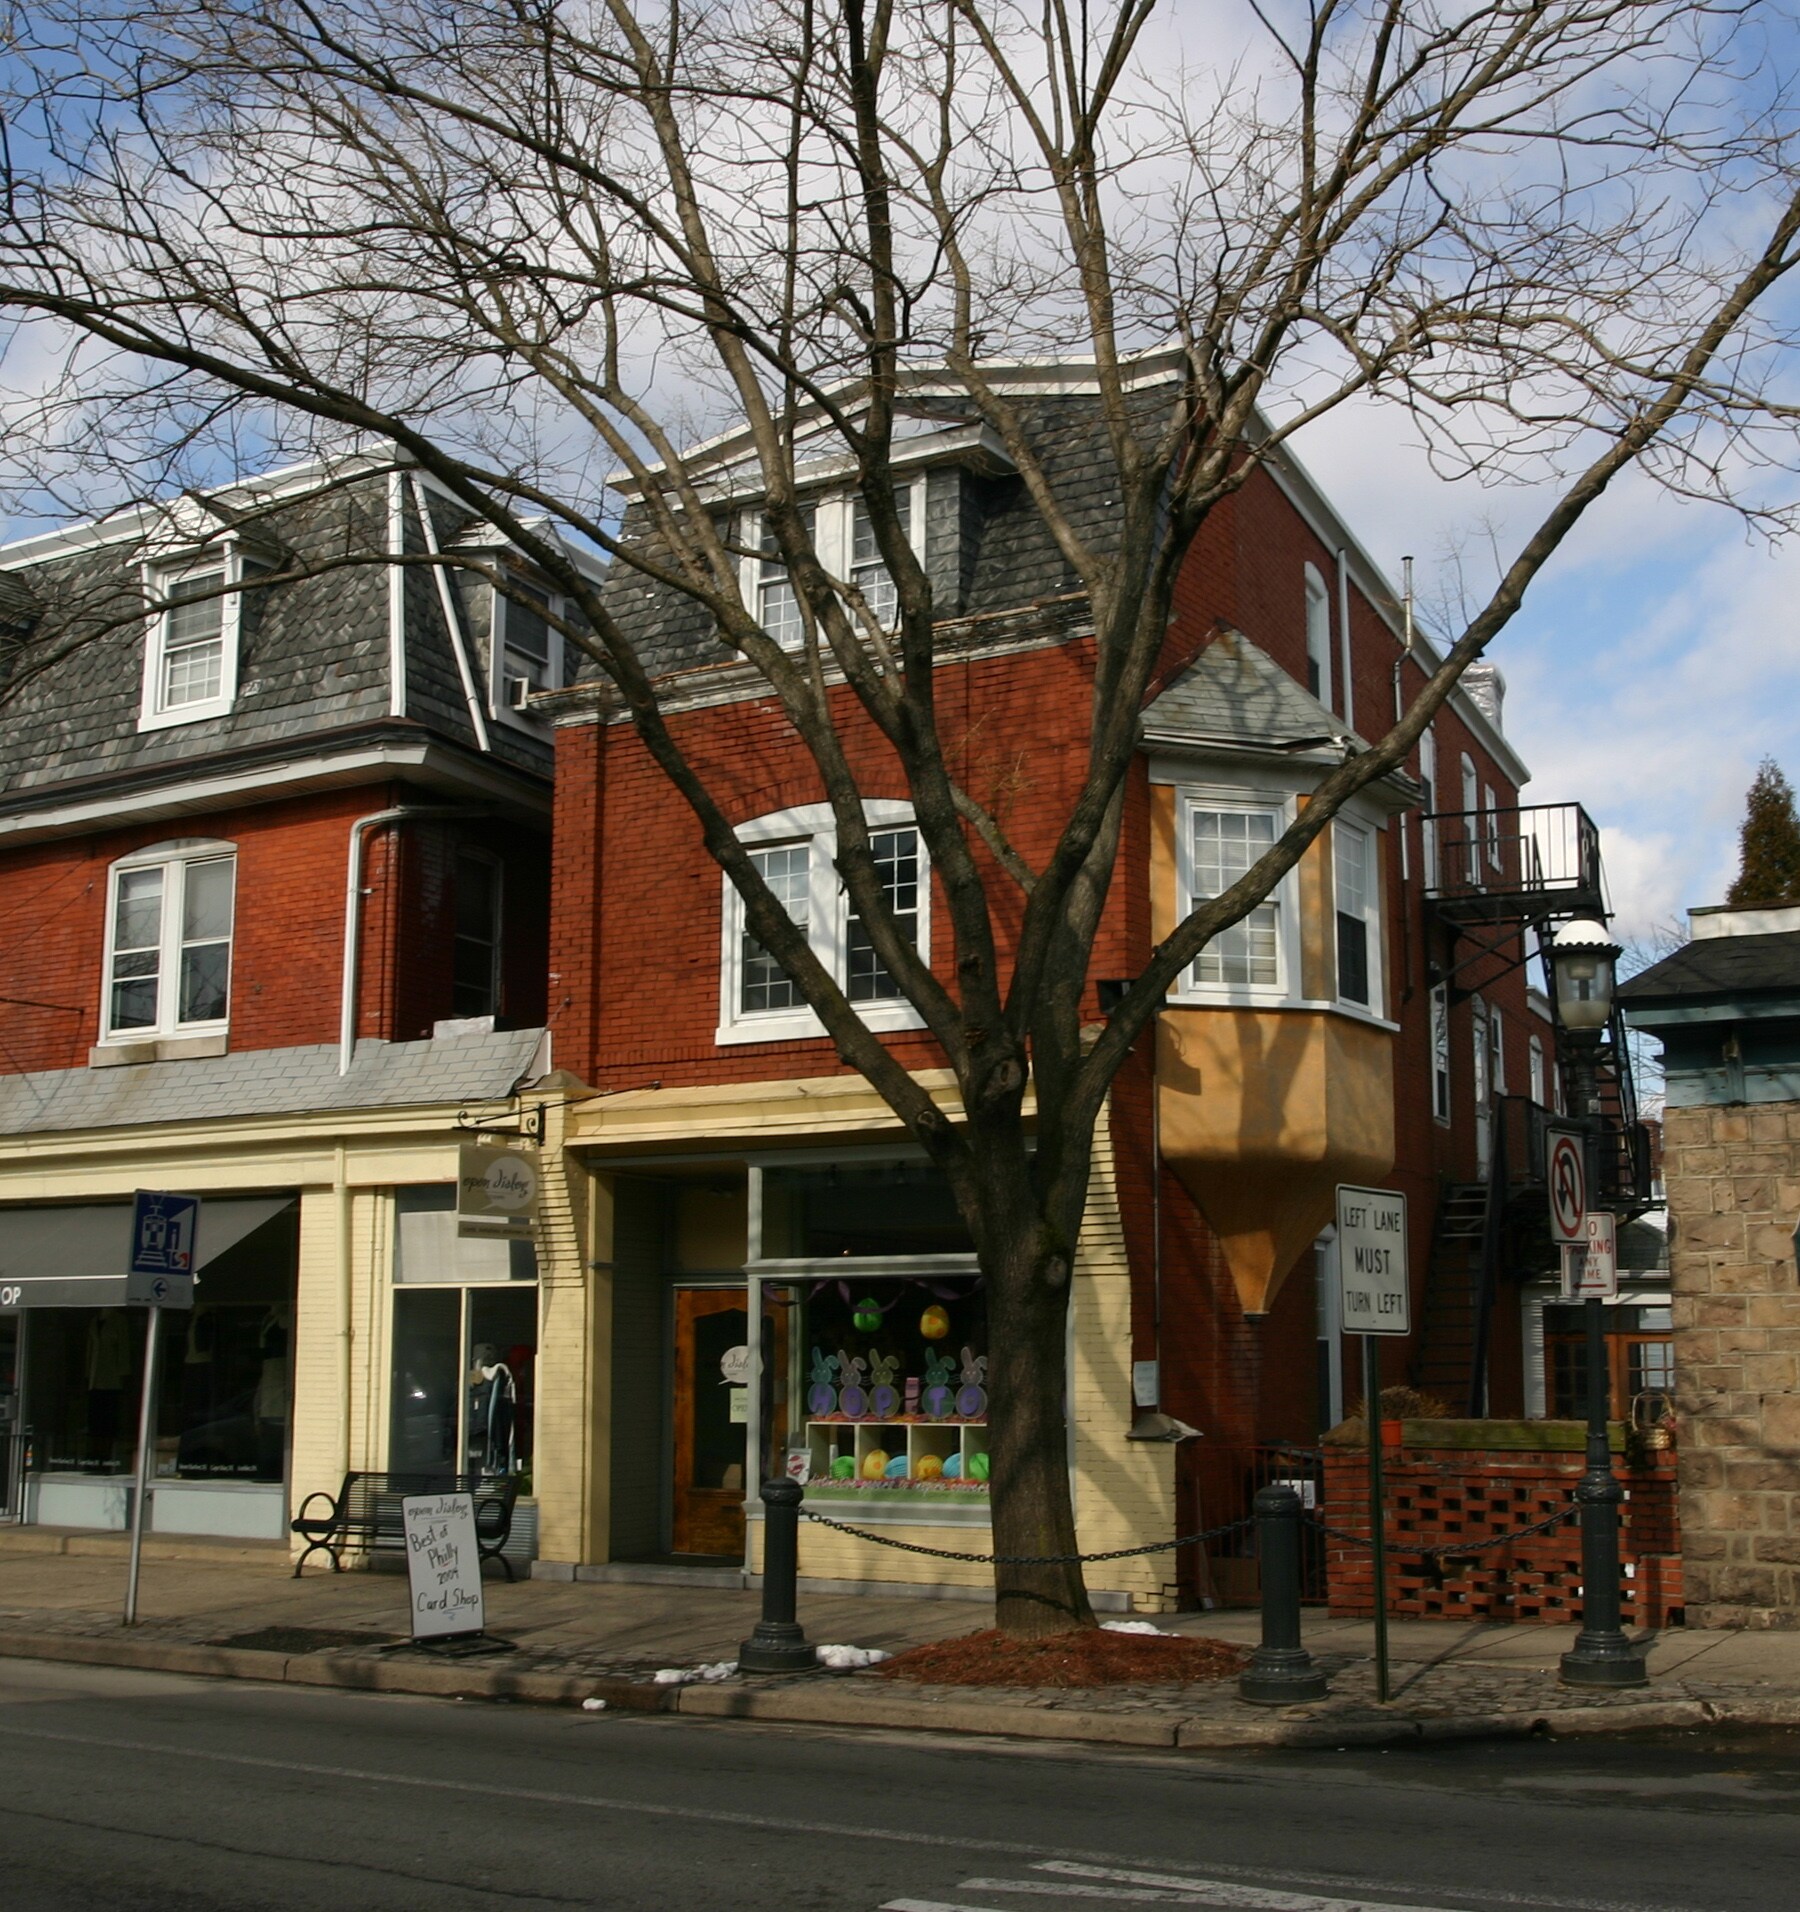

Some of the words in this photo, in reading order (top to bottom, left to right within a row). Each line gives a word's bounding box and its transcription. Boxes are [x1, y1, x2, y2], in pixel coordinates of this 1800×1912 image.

[463, 1177, 490, 1192] open
[493, 1168, 529, 1199] dialog
[1343, 1206, 1367, 1228] LEFT
[1374, 1210, 1400, 1233] LANE
[1589, 1221, 1597, 1236] O
[1355, 1247, 1391, 1275] MUST
[1576, 1269, 1601, 1280] TIME
[0, 1286, 22, 1305] OP
[1346, 1290, 1371, 1313] TURN
[1377, 1293, 1403, 1315] LEFT
[810, 1384, 893, 1417] HOP
[928, 1385, 980, 1416] TO
[408, 1507, 433, 1520] open
[435, 1497, 468, 1520] dialog
[409, 1525, 437, 1552] Best
[440, 1523, 449, 1538] of
[427, 1542, 459, 1569] Philly
[417, 1588, 448, 1612] Card
[453, 1587, 479, 1611] Shop
